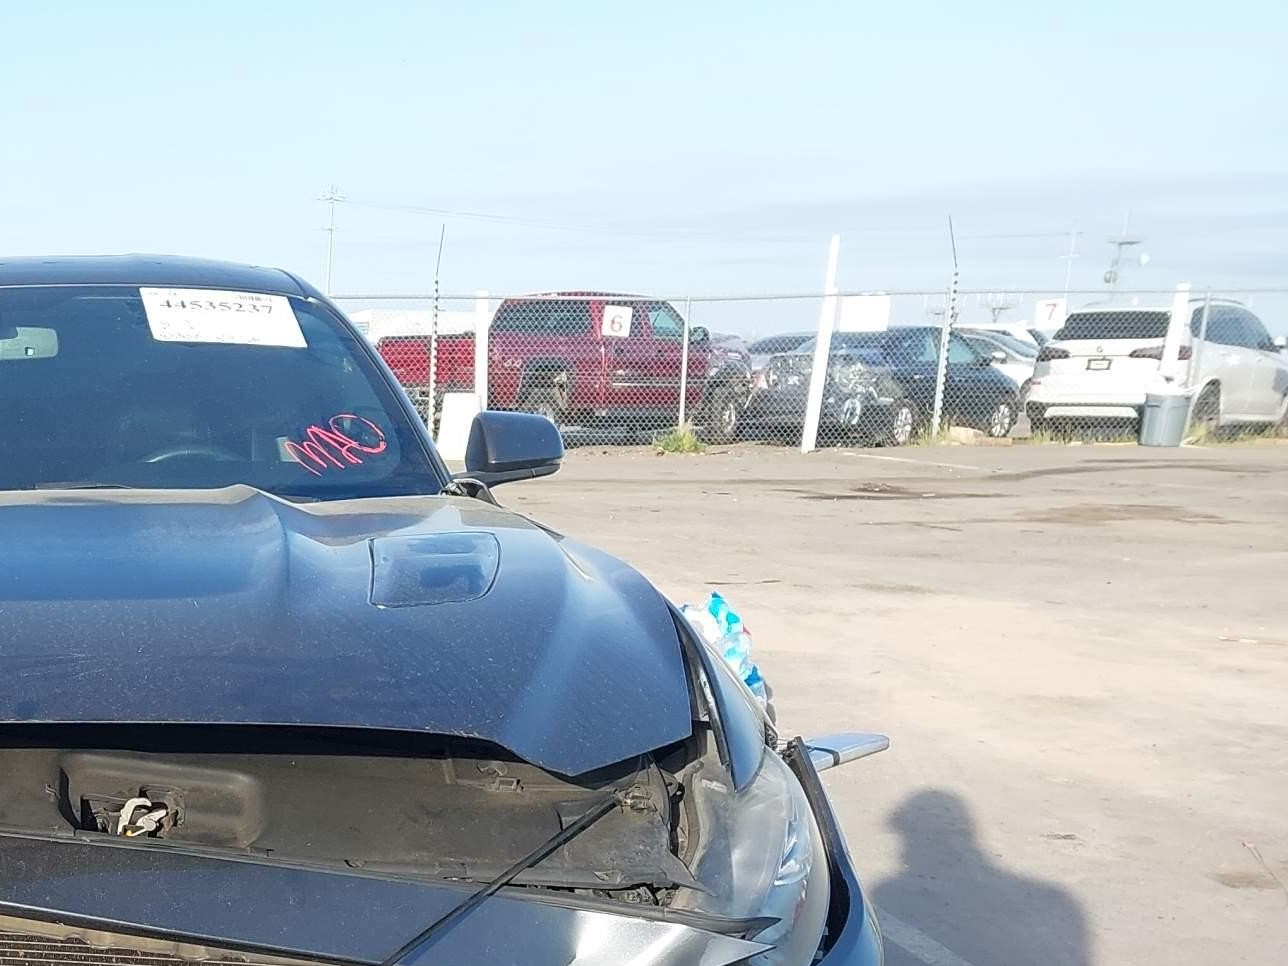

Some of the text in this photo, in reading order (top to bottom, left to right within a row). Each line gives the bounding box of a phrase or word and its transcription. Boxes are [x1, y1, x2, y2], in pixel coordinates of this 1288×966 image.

[159, 299, 273, 315] 44535237
[1045, 303, 1057, 321] 7
[610, 314, 623, 333] 6
